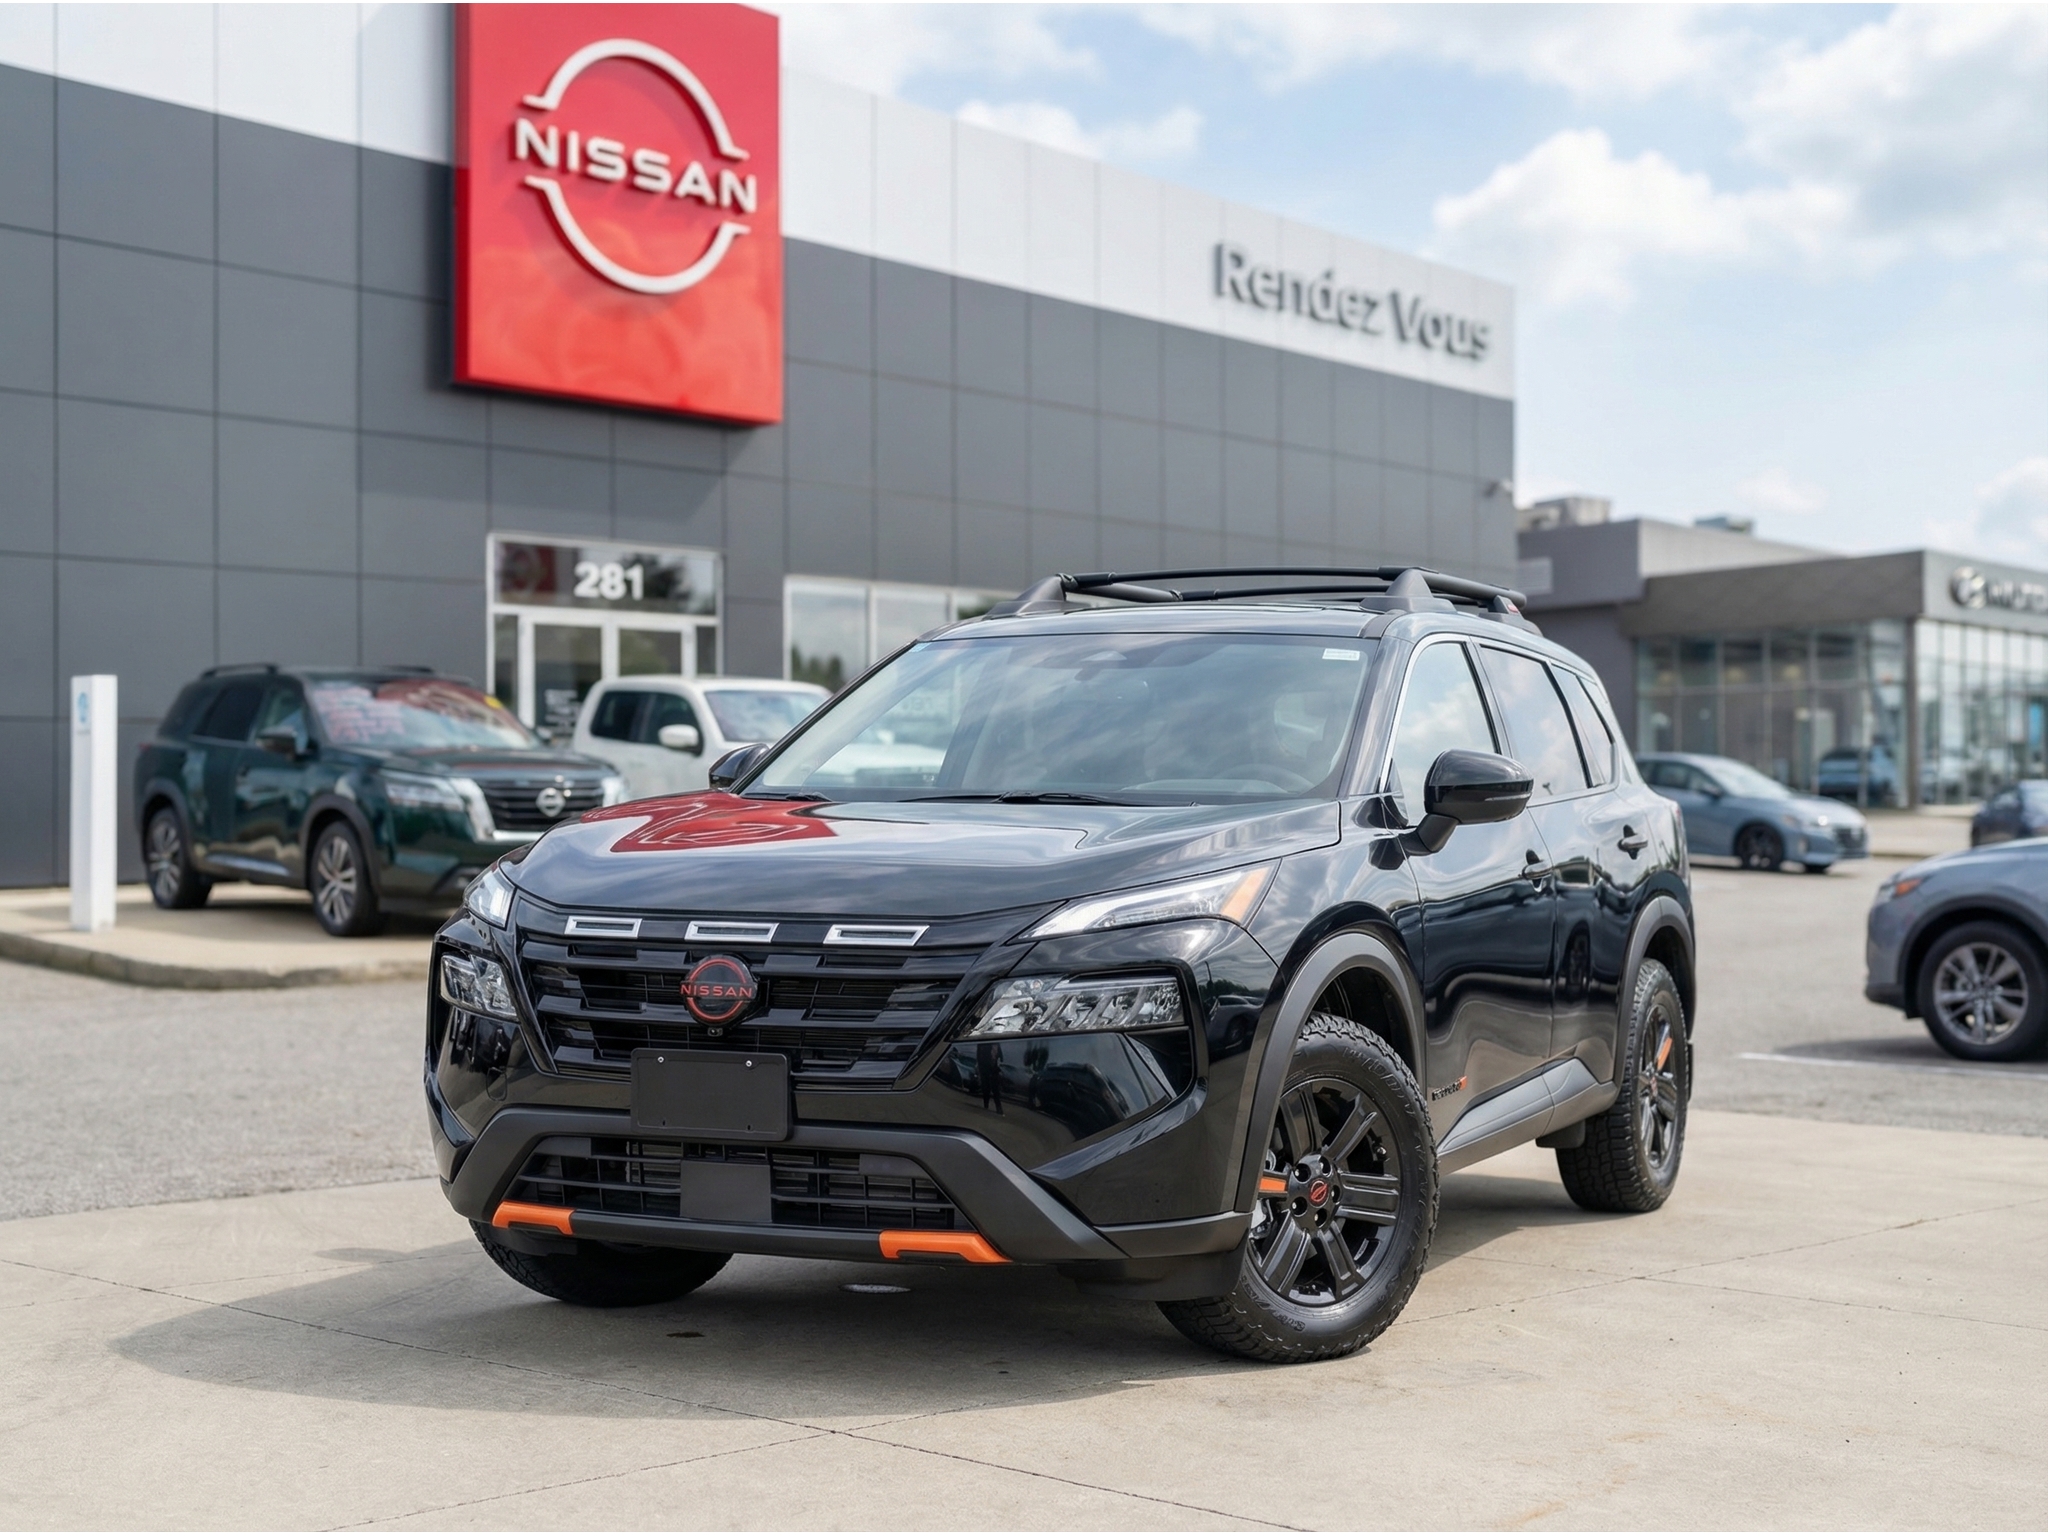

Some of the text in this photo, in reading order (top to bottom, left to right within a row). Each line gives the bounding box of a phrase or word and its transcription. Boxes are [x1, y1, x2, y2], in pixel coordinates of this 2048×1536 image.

[515, 118, 757, 213] NISSAN
[1388, 289, 1490, 360] Vous
[573, 561, 644, 601] 281
[681, 984, 752, 998] NISSAN
